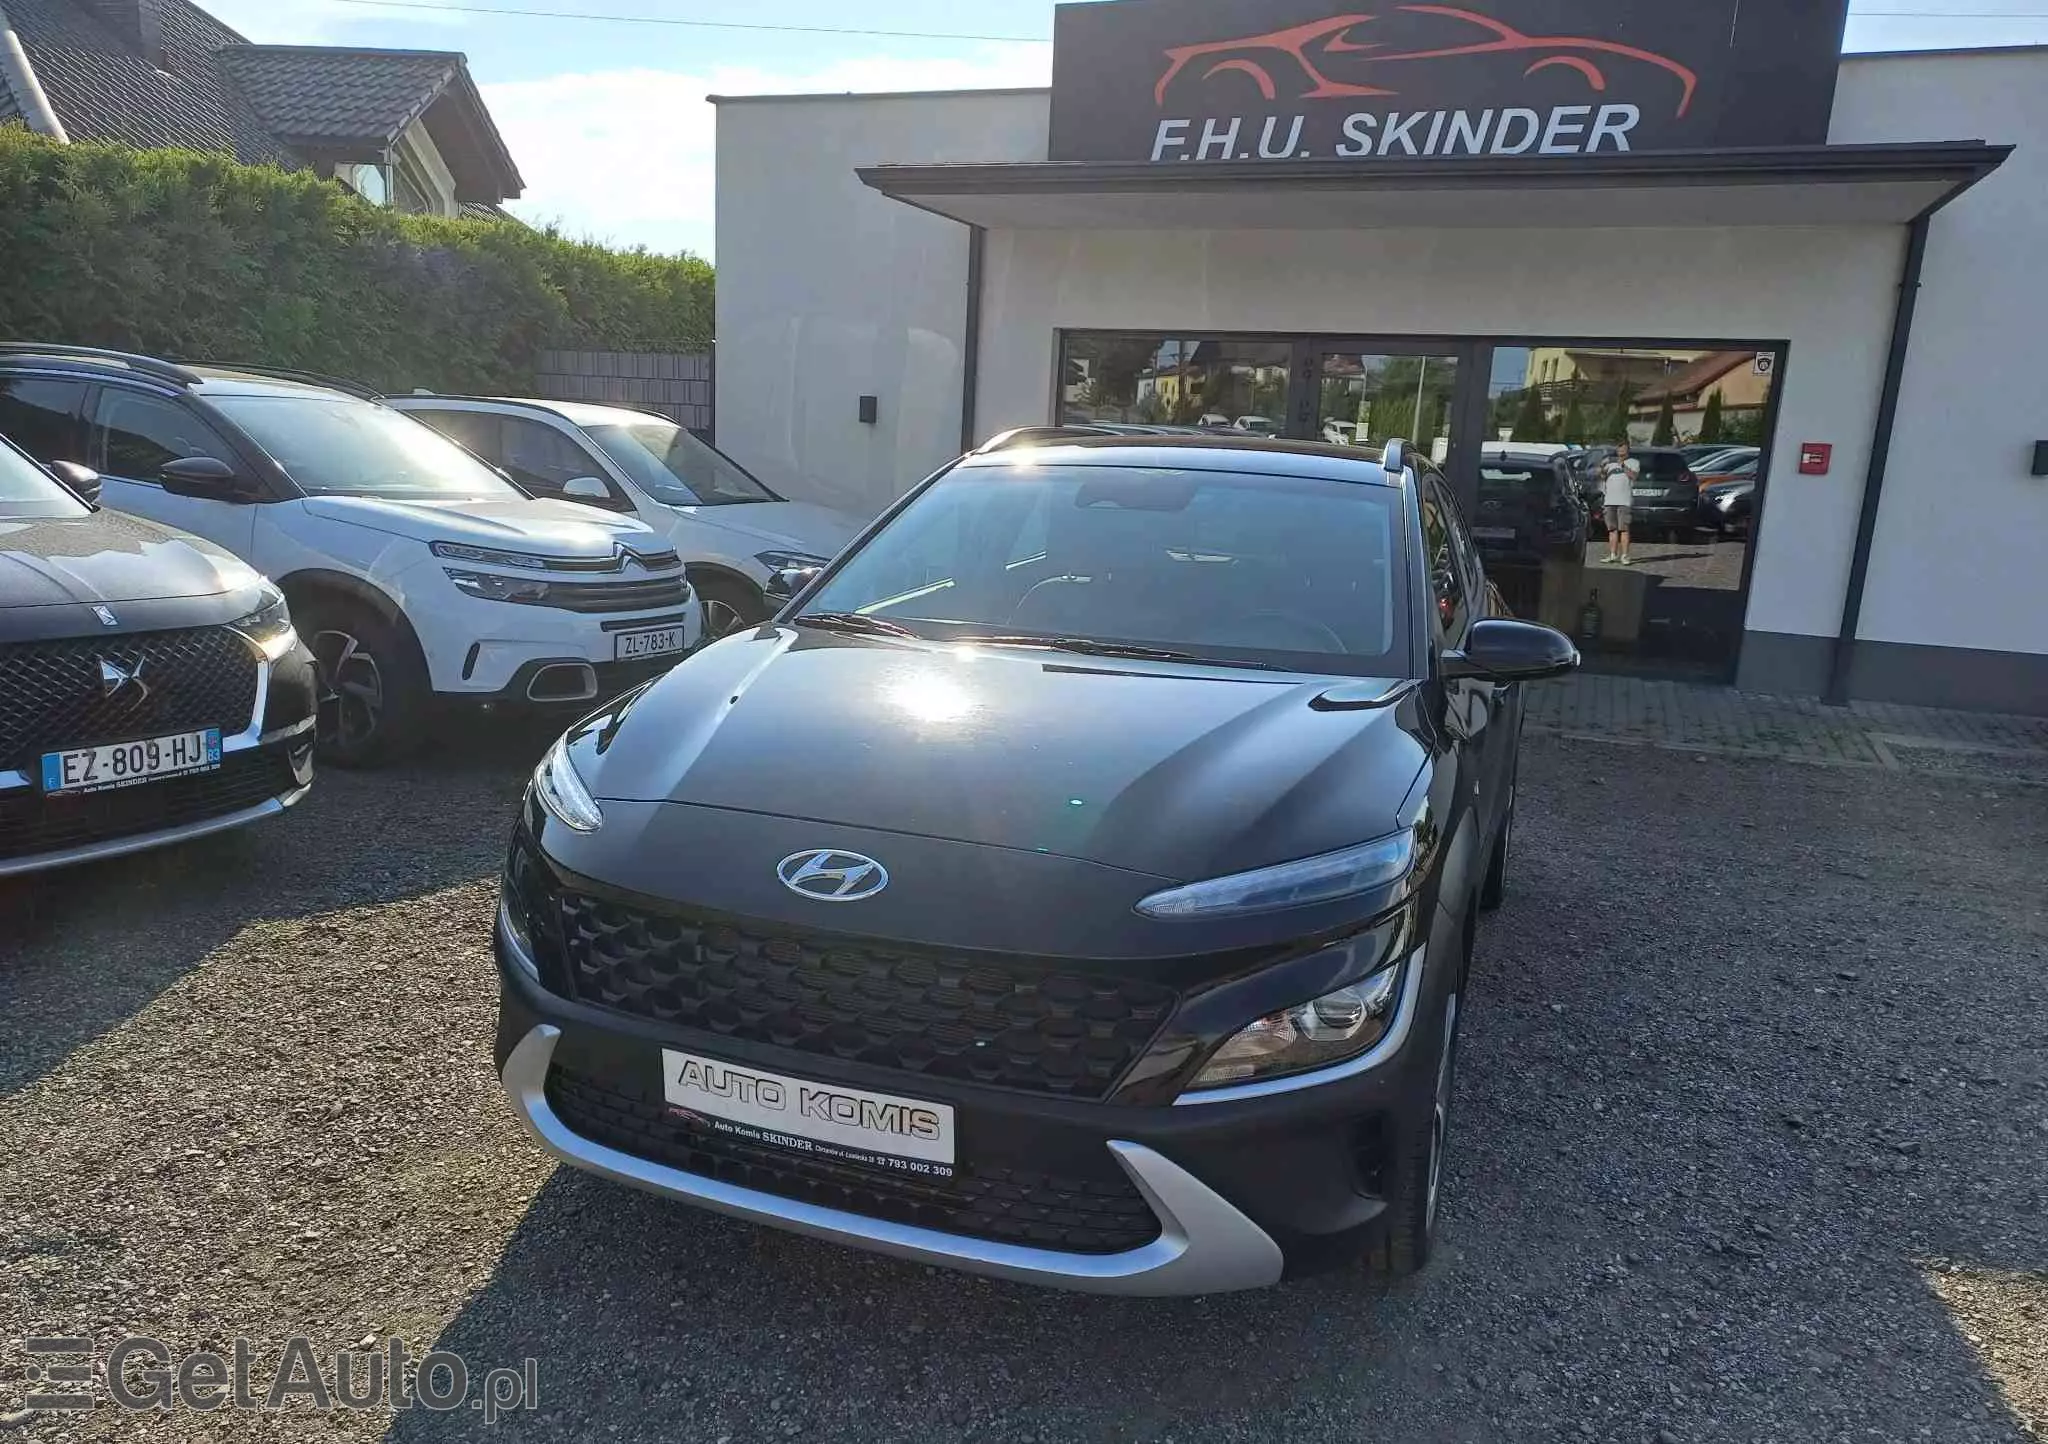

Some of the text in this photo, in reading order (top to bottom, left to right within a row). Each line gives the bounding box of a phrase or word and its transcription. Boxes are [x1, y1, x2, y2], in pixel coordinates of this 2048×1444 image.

[1150, 103, 1641, 162] F.H.U. SKINDER
[624, 631, 677, 655] ZL-783-K
[62, 733, 202, 785] EZ-809-HJ
[677, 1059, 941, 1141] AUTO KOMIS
[714, 1120, 953, 1177] Auto Komis SKINDER 793 002 309
